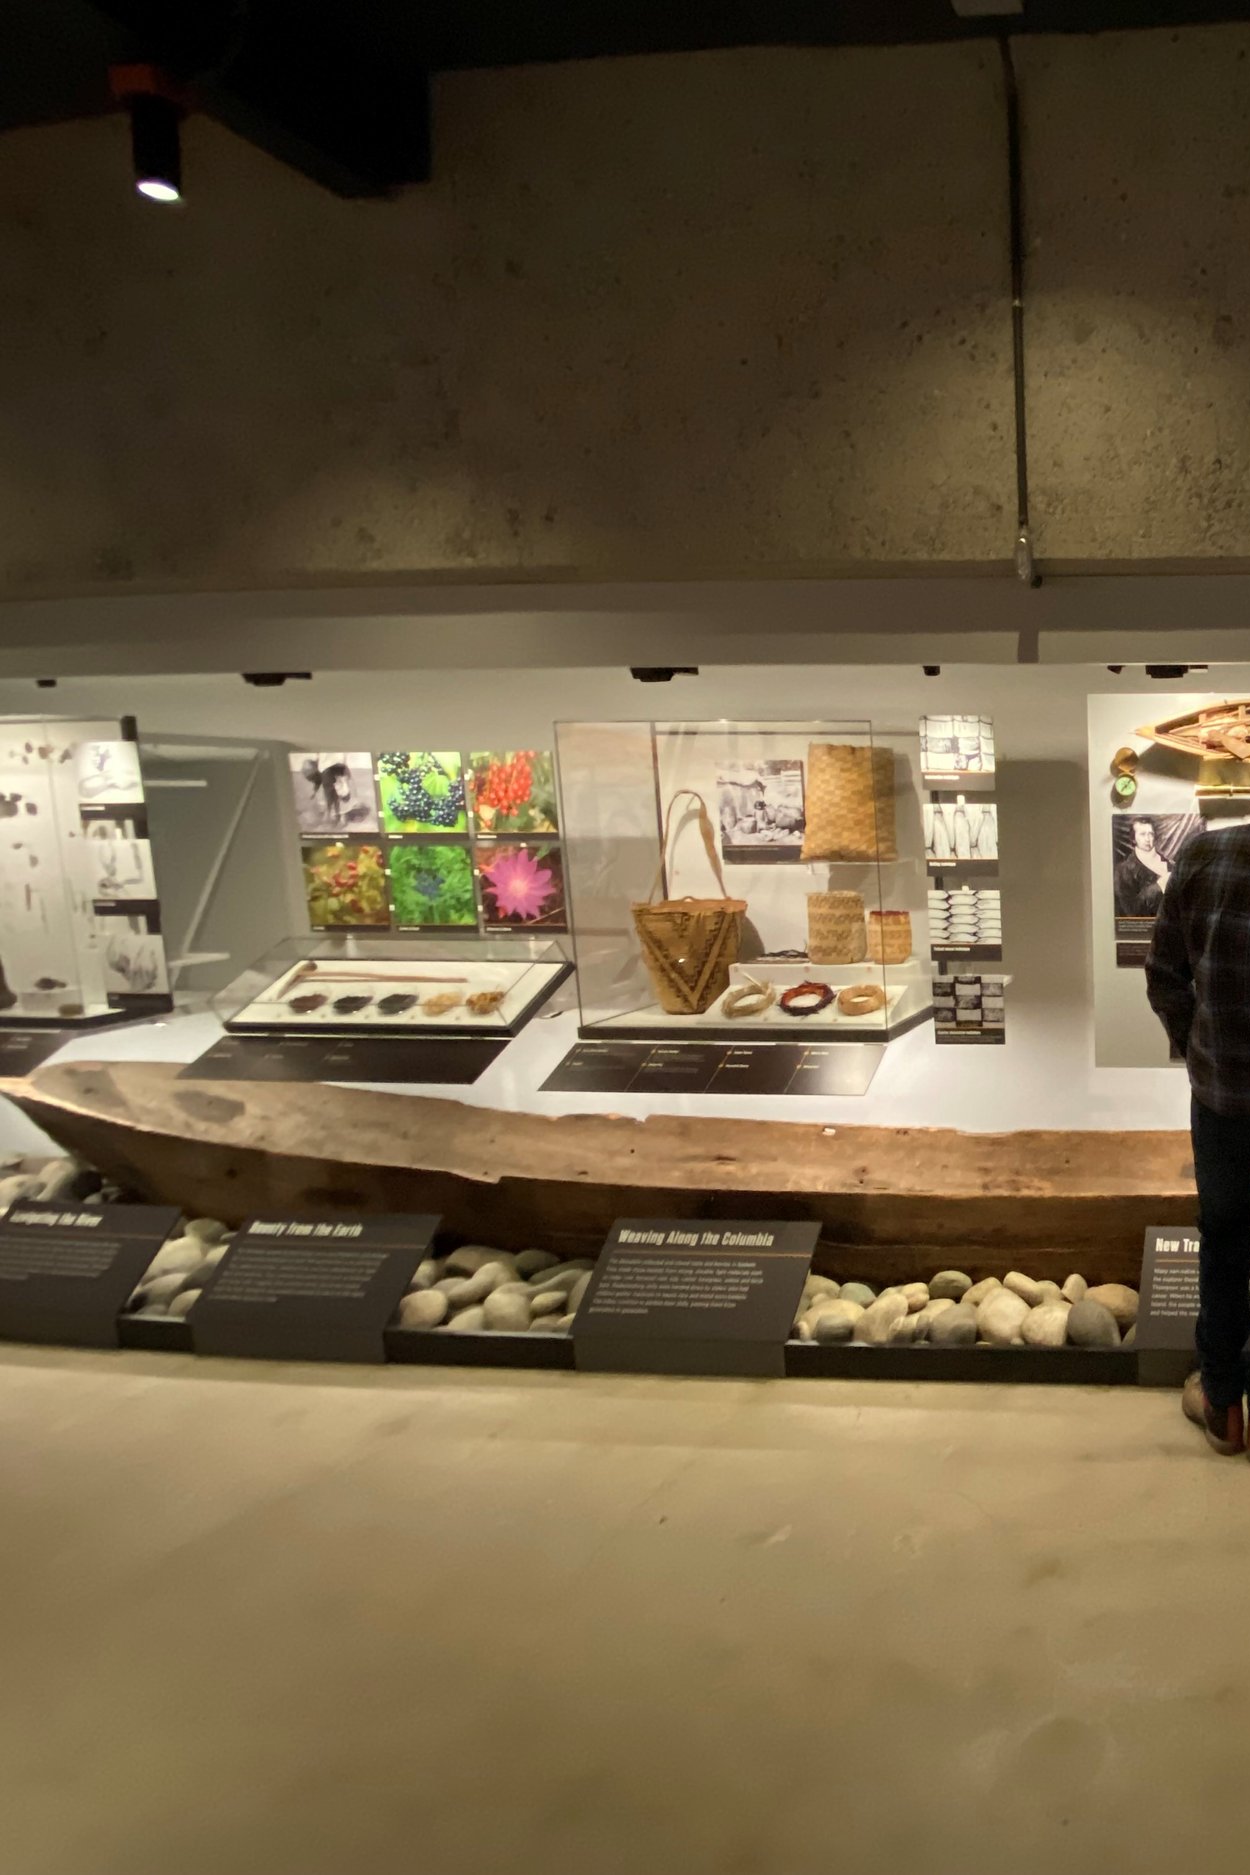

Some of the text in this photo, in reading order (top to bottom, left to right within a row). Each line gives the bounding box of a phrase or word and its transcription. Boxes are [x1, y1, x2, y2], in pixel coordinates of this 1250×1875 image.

[286, 1222, 314, 1236] from
[312, 1222, 333, 1237] the
[332, 1223, 363, 1237] Earth
[618, 1229, 774, 1246] Weaving Along the Columbia
[1155, 1237, 1200, 1252] New Tra
